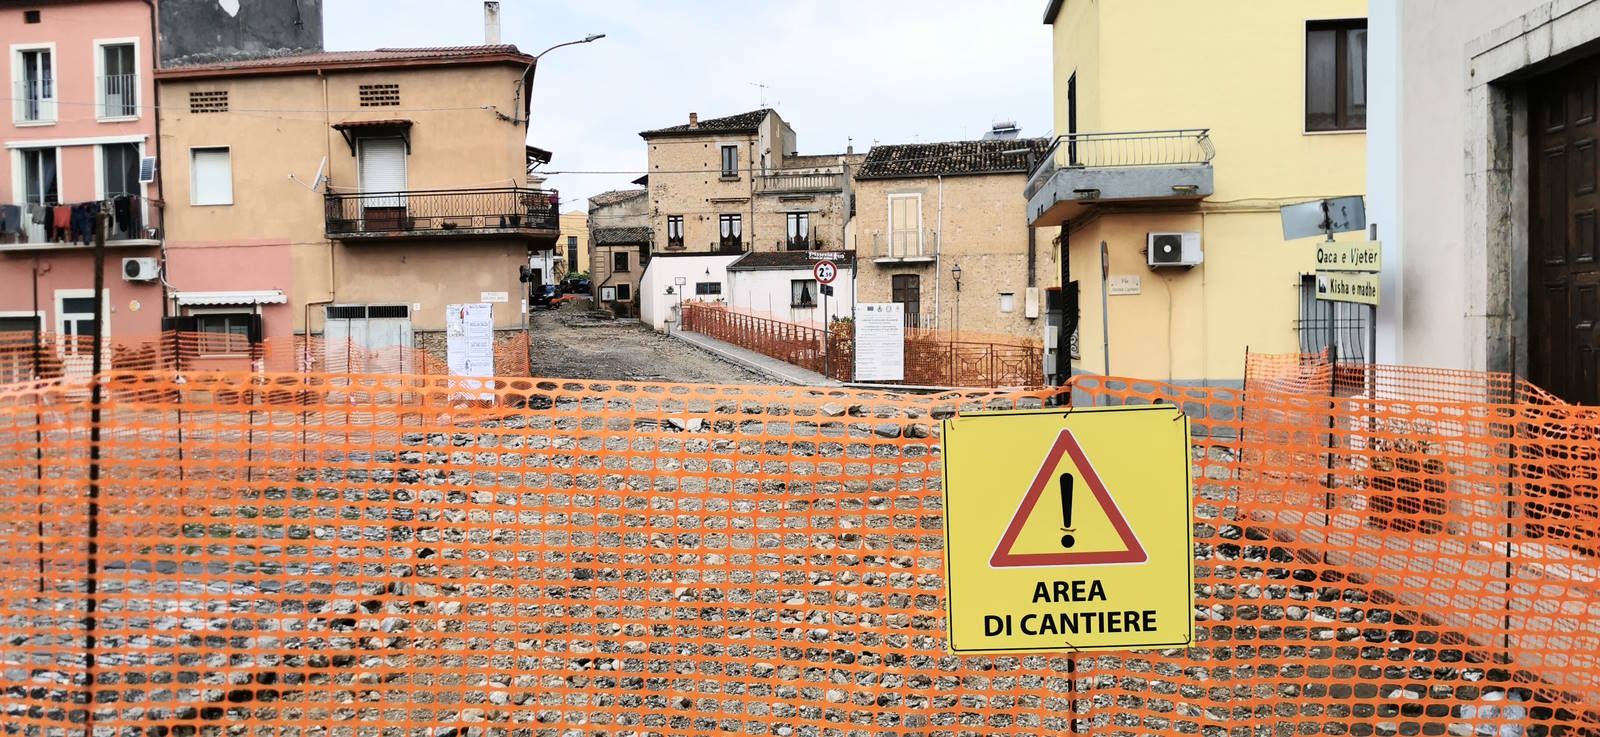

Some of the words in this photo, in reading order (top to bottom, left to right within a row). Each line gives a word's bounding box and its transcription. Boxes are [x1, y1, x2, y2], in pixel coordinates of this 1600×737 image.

[1317, 248, 1337, 264] Qaca
[1342, 253, 1346, 263] e
[1350, 248, 1378, 266] Vjetër
[819, 267, 824, 278] 2
[1330, 278, 1349, 294] Kisha
[1352, 282, 1356, 295] e
[1356, 282, 1376, 297] madhe
[1032, 579, 1107, 603] AREA
[984, 614, 1012, 637] DI
[1020, 610, 1157, 636] CANTIERE
